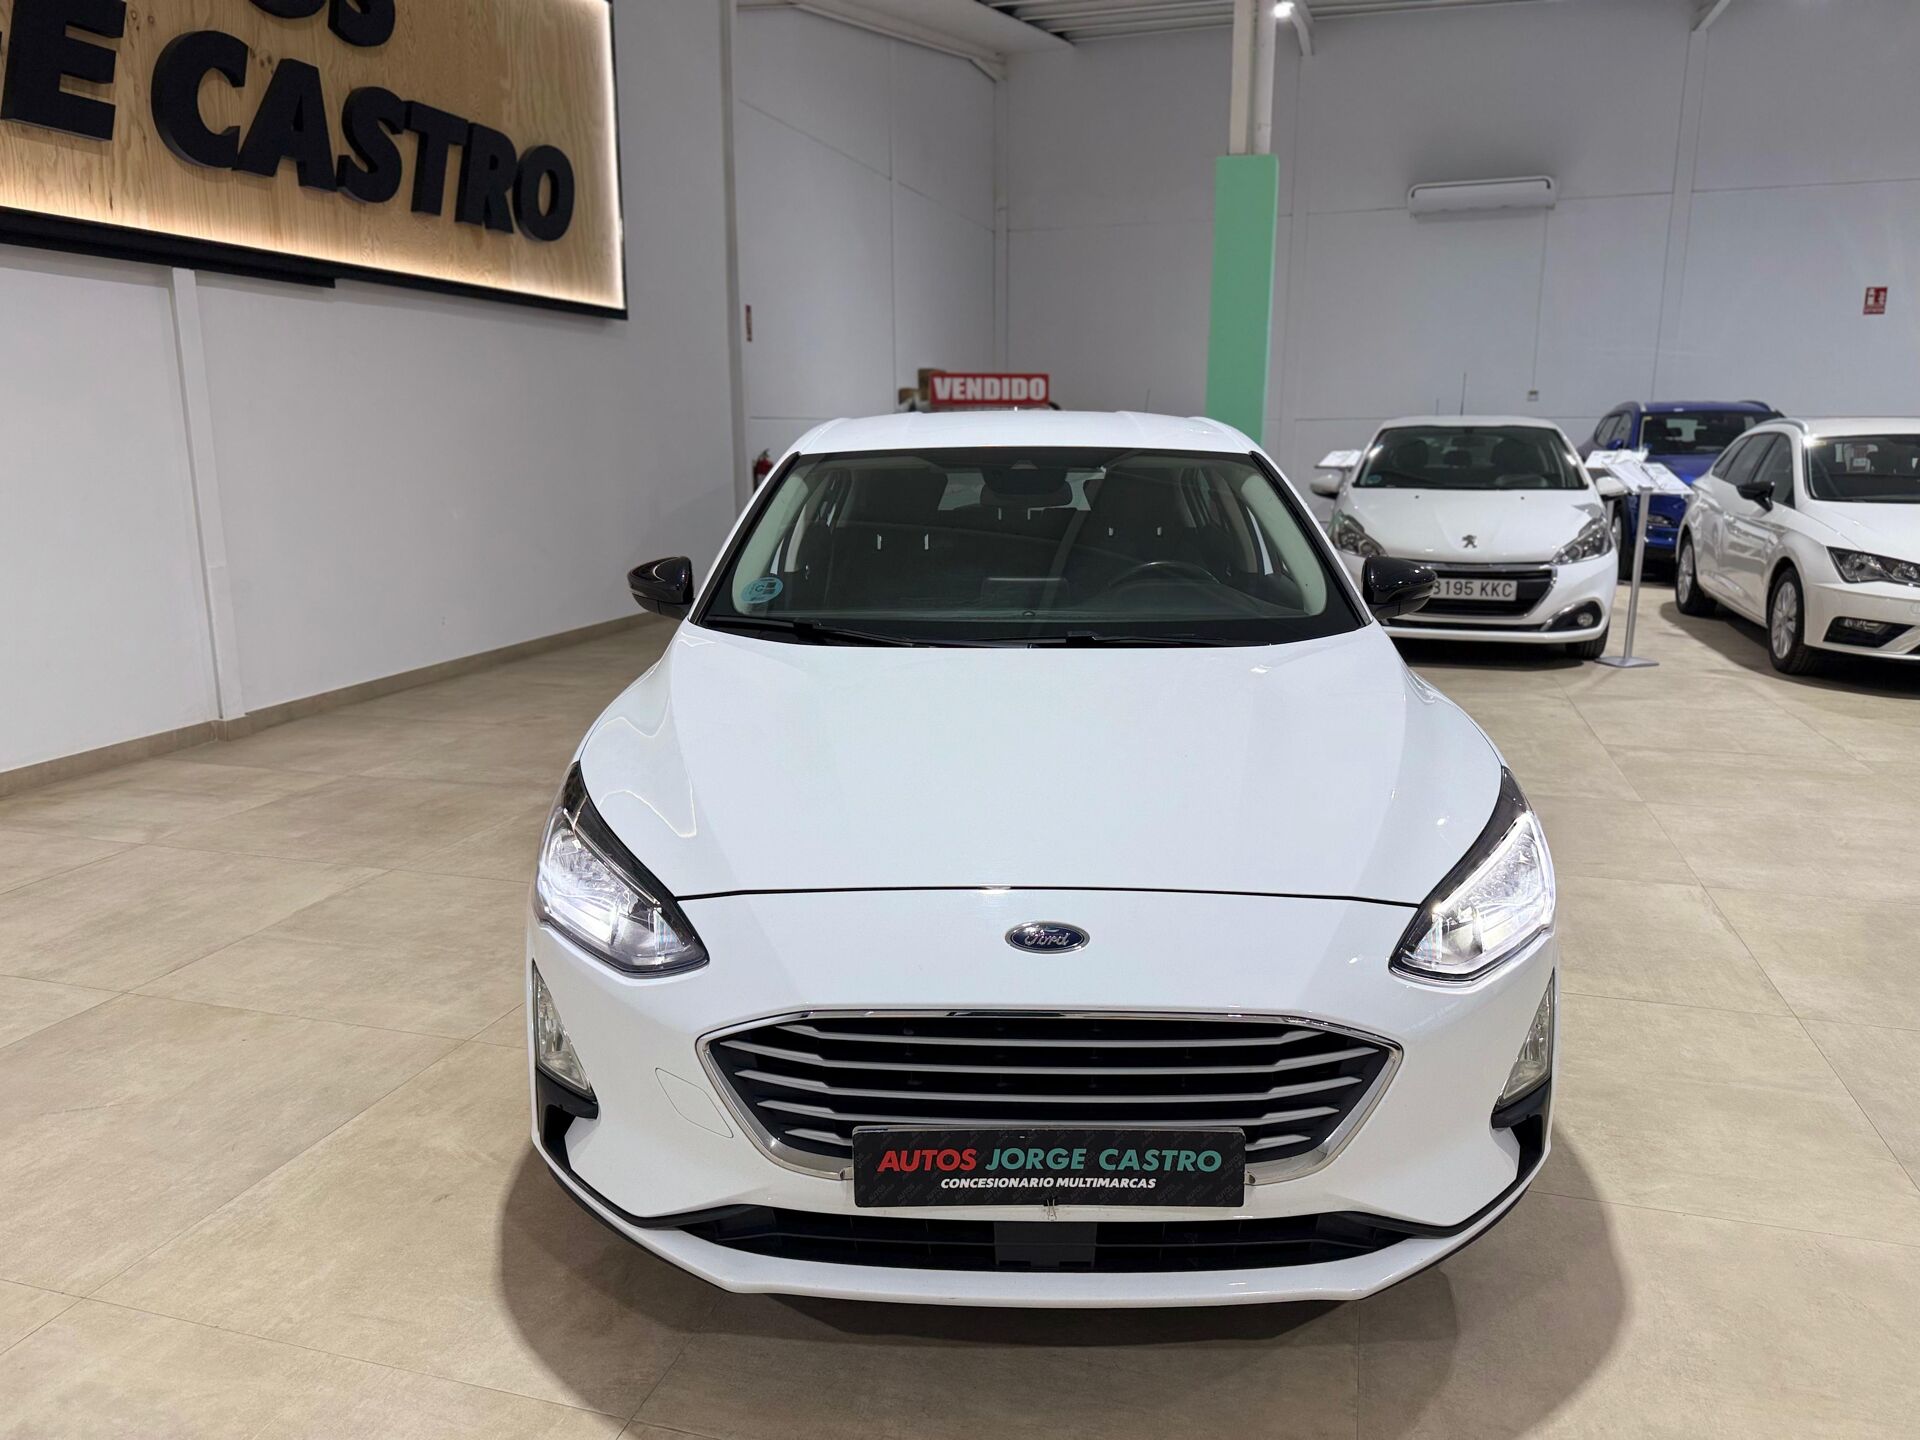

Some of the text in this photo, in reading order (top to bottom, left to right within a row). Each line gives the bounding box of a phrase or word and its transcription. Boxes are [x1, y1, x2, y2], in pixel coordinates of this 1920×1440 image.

[151, 30, 575, 242] CASTRO
[933, 377, 1047, 400] VENDIDO
[1480, 582, 1513, 598] KKC
[1024, 928, 1070, 946] Ford
[876, 1148, 1222, 1172] AUTOS JORGE CASTRO
[941, 1177, 1157, 1189] CONCESIONARIO MULTIMARCAS
